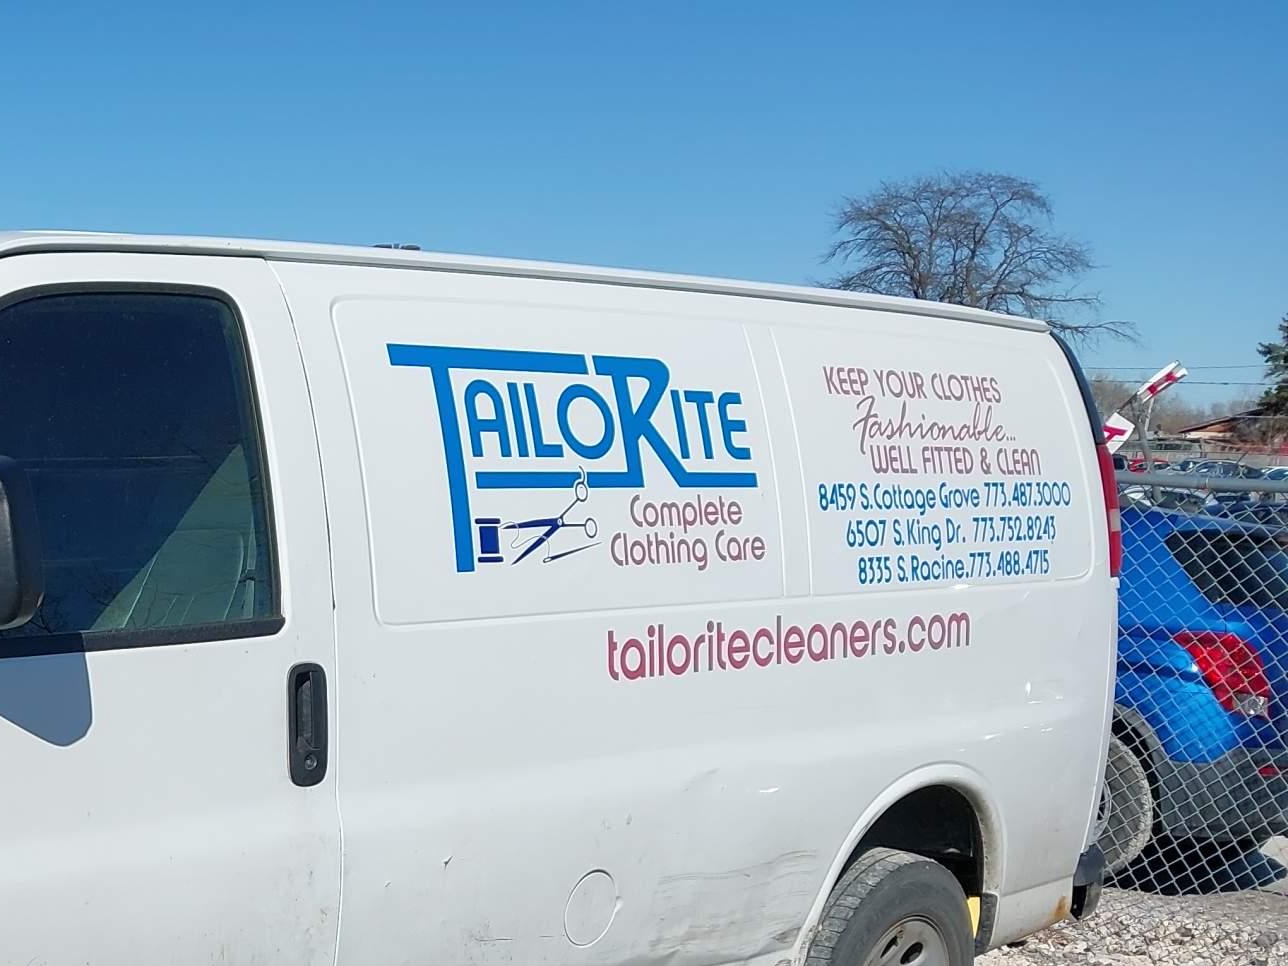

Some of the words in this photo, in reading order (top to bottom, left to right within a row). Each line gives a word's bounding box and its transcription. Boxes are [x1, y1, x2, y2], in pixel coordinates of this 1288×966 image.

[822, 366, 869, 396] KEEP
[873, 369, 928, 399] YOUR
[931, 373, 1002, 403] CLOTHES
[869, 445, 918, 474] WELL
[921, 446, 974, 474] FITTED
[979, 448, 991, 475] &
[996, 448, 1042, 476] CLEAN
[818, 483, 856, 511] 8459
[939, 481, 980, 509] Grove
[984, 481, 1071, 507] 773.487.3000
[630, 493, 743, 534] Complete
[846, 519, 887, 547] 6507
[945, 517, 966, 544] Dr.
[972, 515, 1056, 544] 773.752.8243
[610, 531, 708, 571] Clothing
[714, 530, 766, 563] Care
[858, 555, 892, 584] 8335
[607, 611, 970, 681] tailoritecleaners.com
